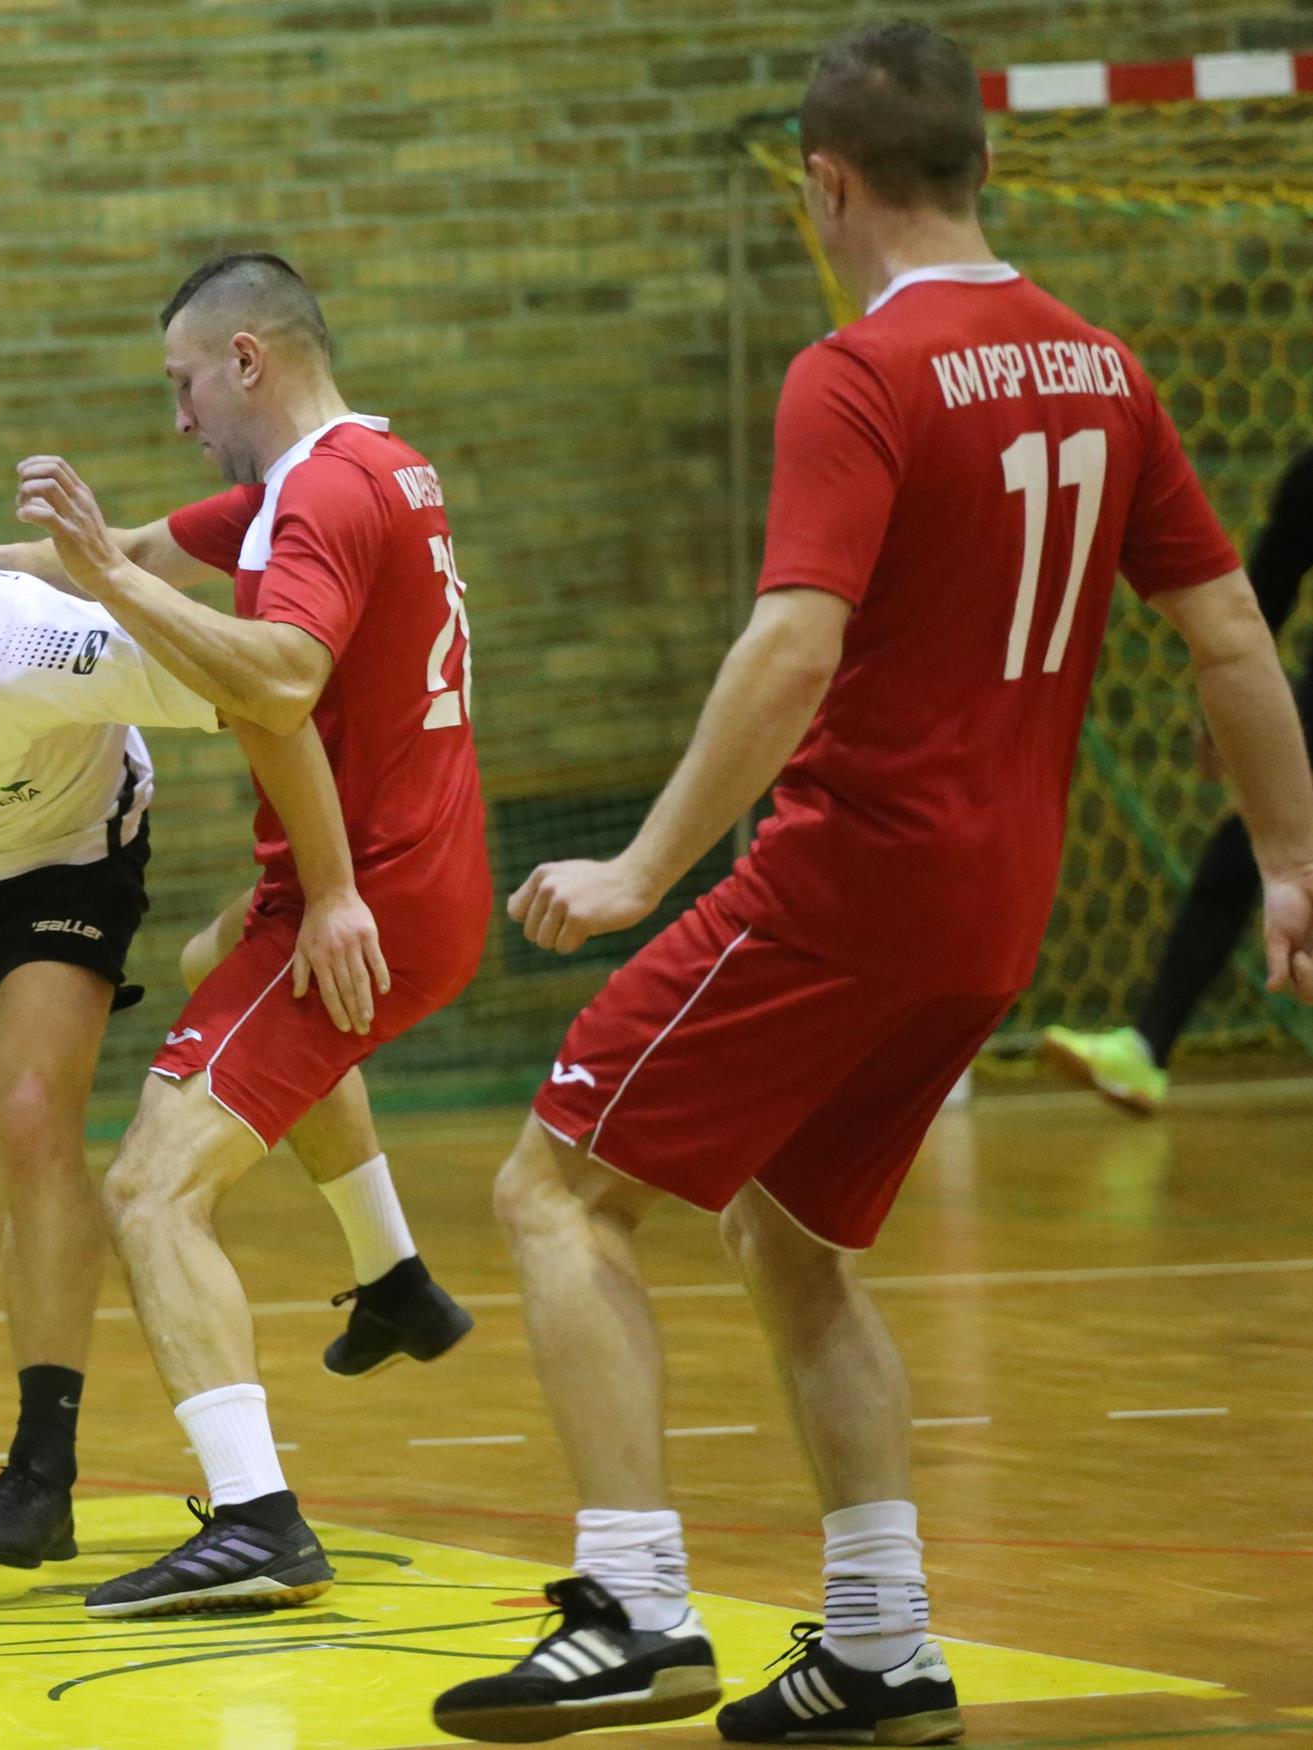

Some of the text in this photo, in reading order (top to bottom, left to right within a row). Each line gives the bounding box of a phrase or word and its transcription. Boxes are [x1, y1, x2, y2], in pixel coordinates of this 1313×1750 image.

[931, 340, 1130, 409] KM PSP LEGNICA
[1001, 429, 1107, 680] 11
